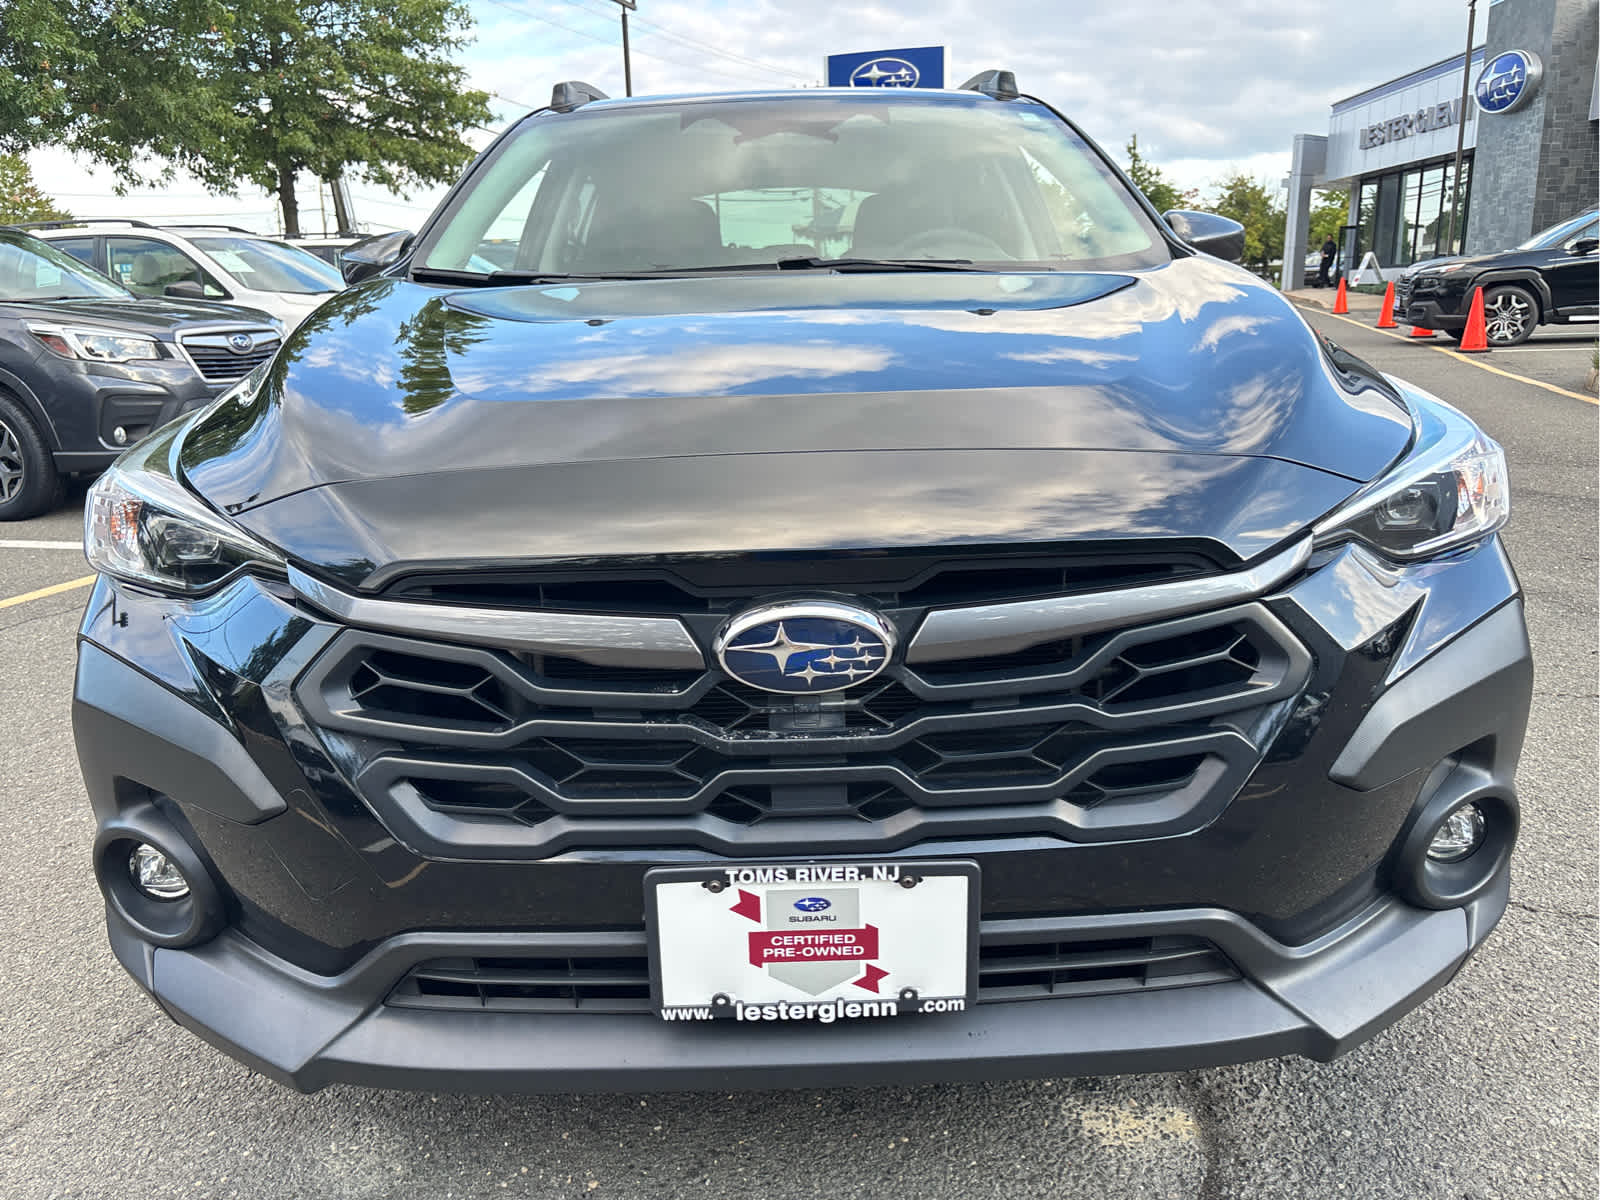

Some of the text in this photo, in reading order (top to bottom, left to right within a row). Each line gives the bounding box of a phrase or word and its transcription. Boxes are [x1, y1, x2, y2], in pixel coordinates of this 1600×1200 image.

[1360, 114, 1413, 150] LESTER
[725, 866, 900, 884] TOMS RIVER, NJ
[788, 914, 837, 923] SUBARU
[770, 933, 856, 946] CERTIFIED
[763, 945, 864, 959] PRE-OWNED
[661, 998, 965, 1024] www. lesterglenn .com
